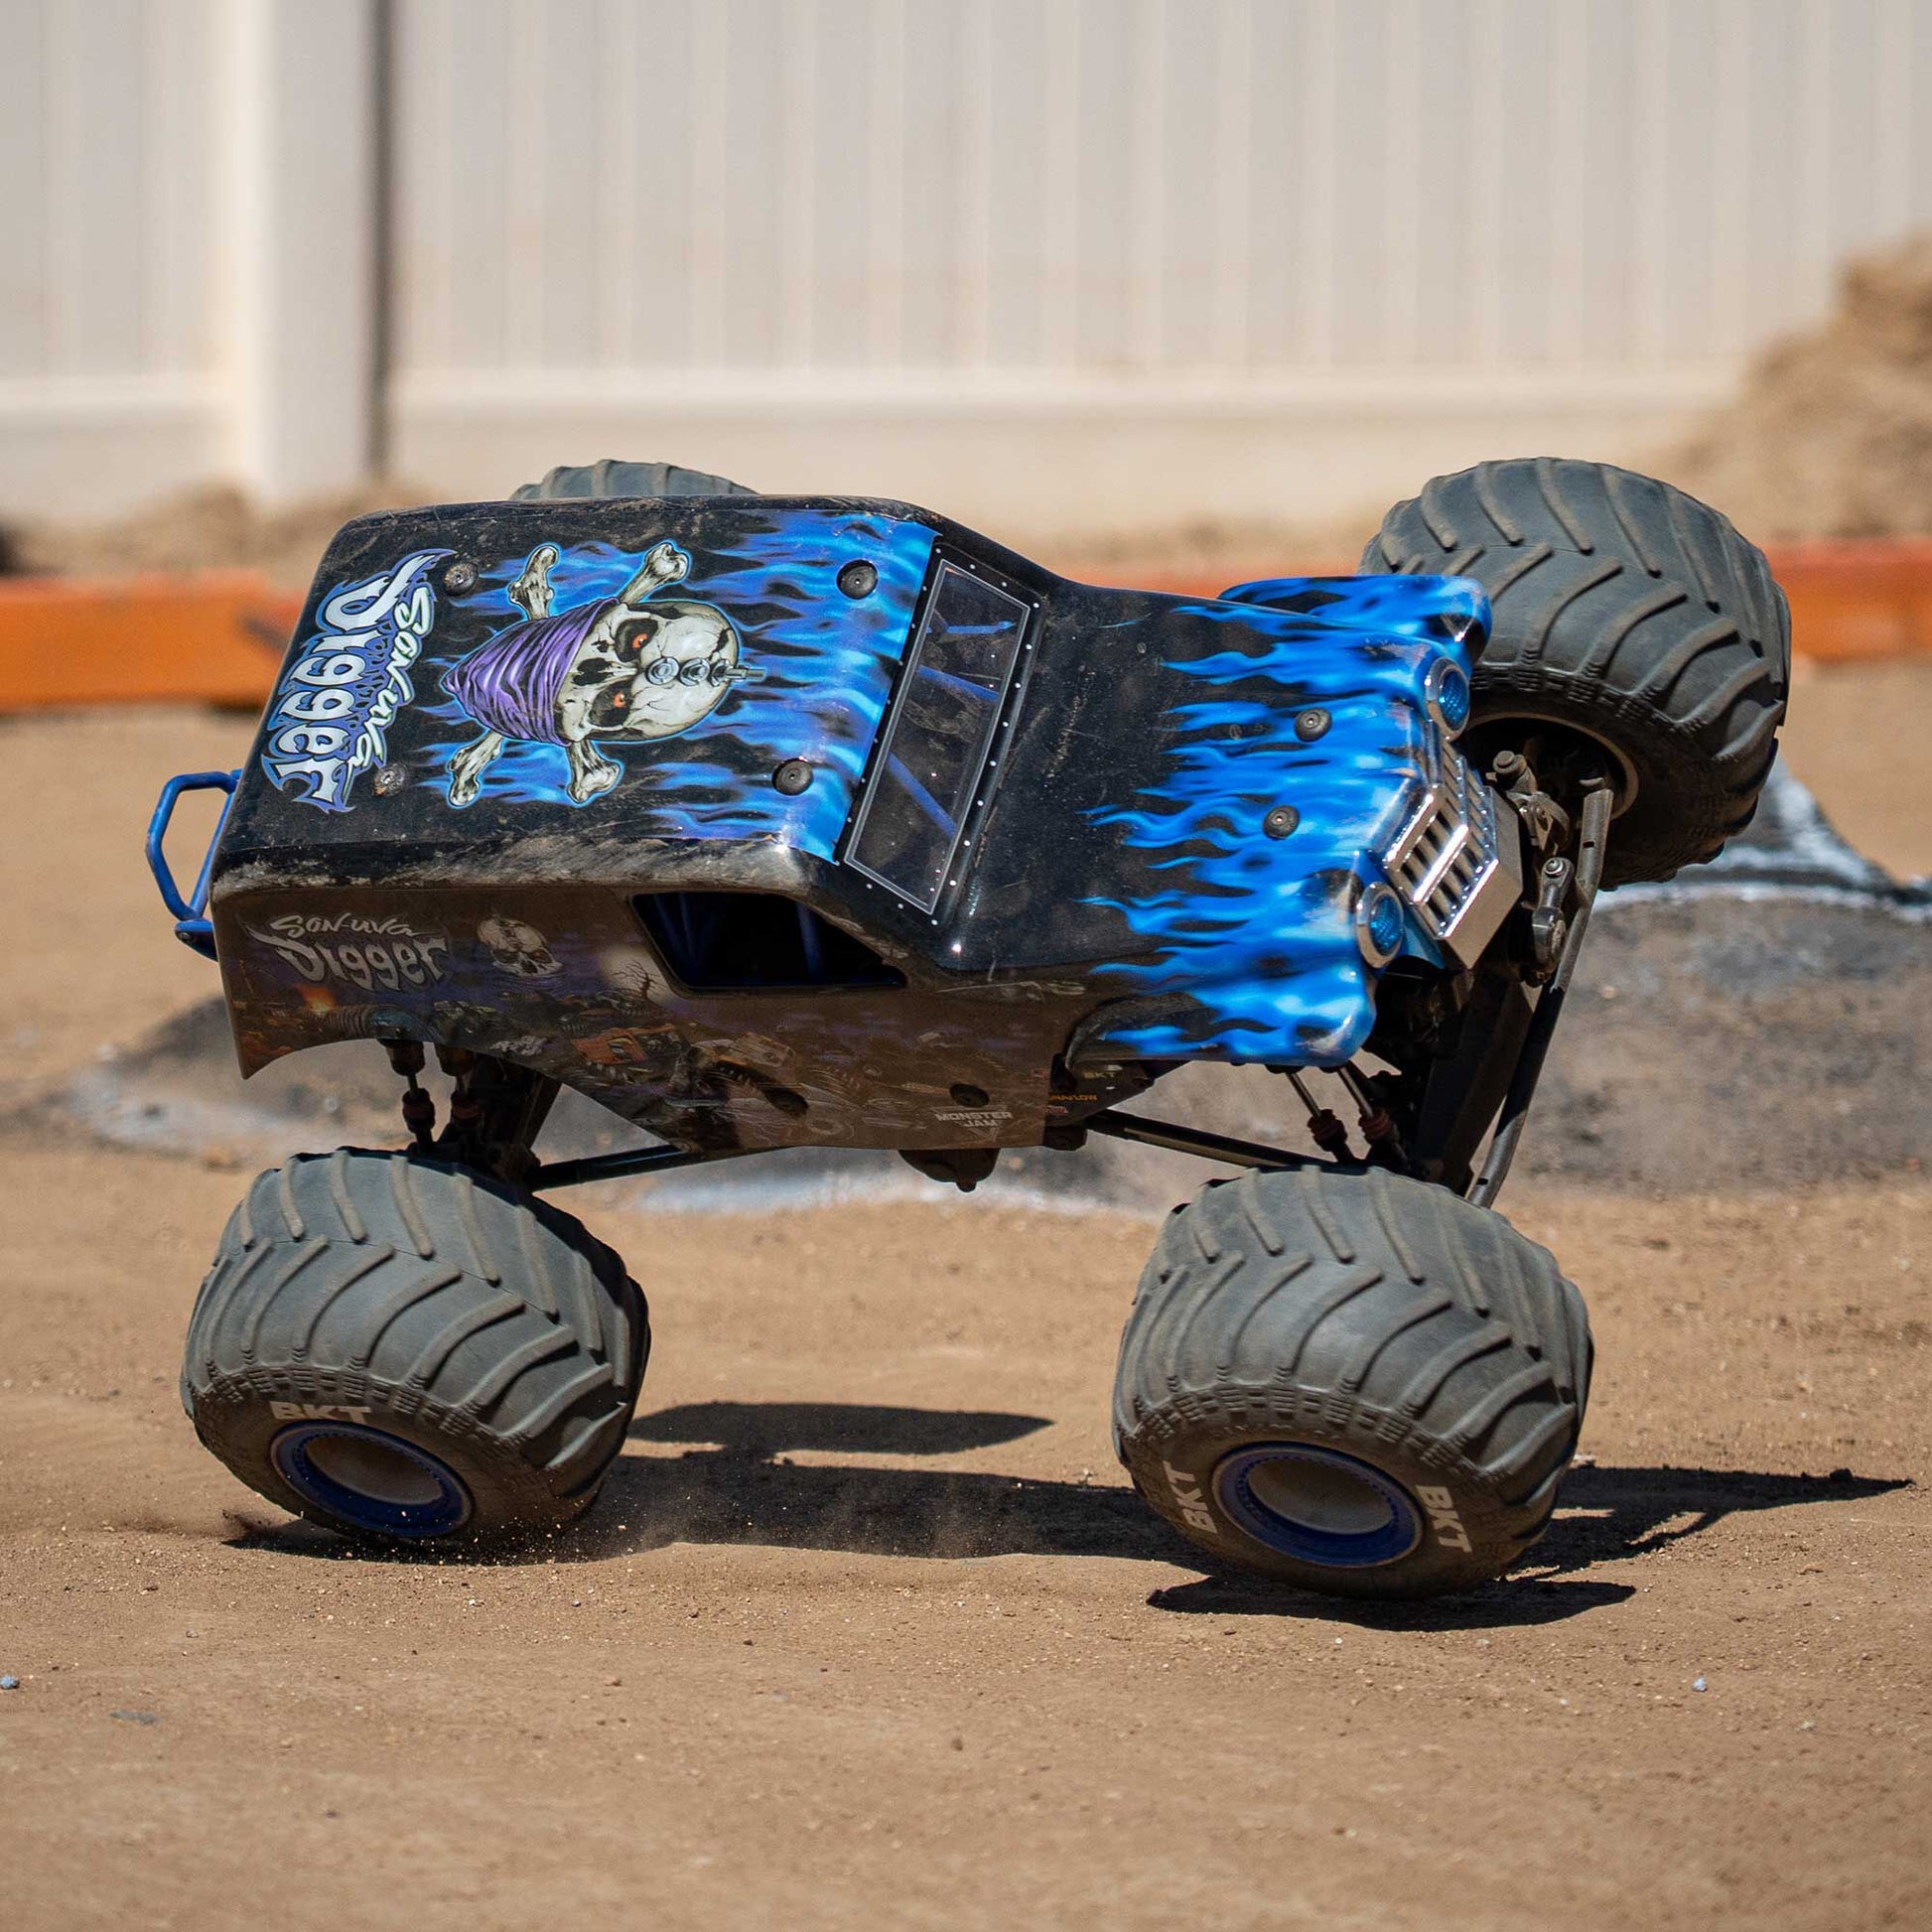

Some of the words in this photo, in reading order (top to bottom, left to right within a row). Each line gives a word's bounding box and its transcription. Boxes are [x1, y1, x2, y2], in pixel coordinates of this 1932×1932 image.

[245, 923, 446, 991] Digger
[934, 1111, 1014, 1122] MONSTER
[963, 1119, 998, 1128] JAM
[269, 1401, 371, 1425] BKT
[1163, 1460, 1217, 1534] BKT
[1415, 1484, 1472, 1553] BKT
